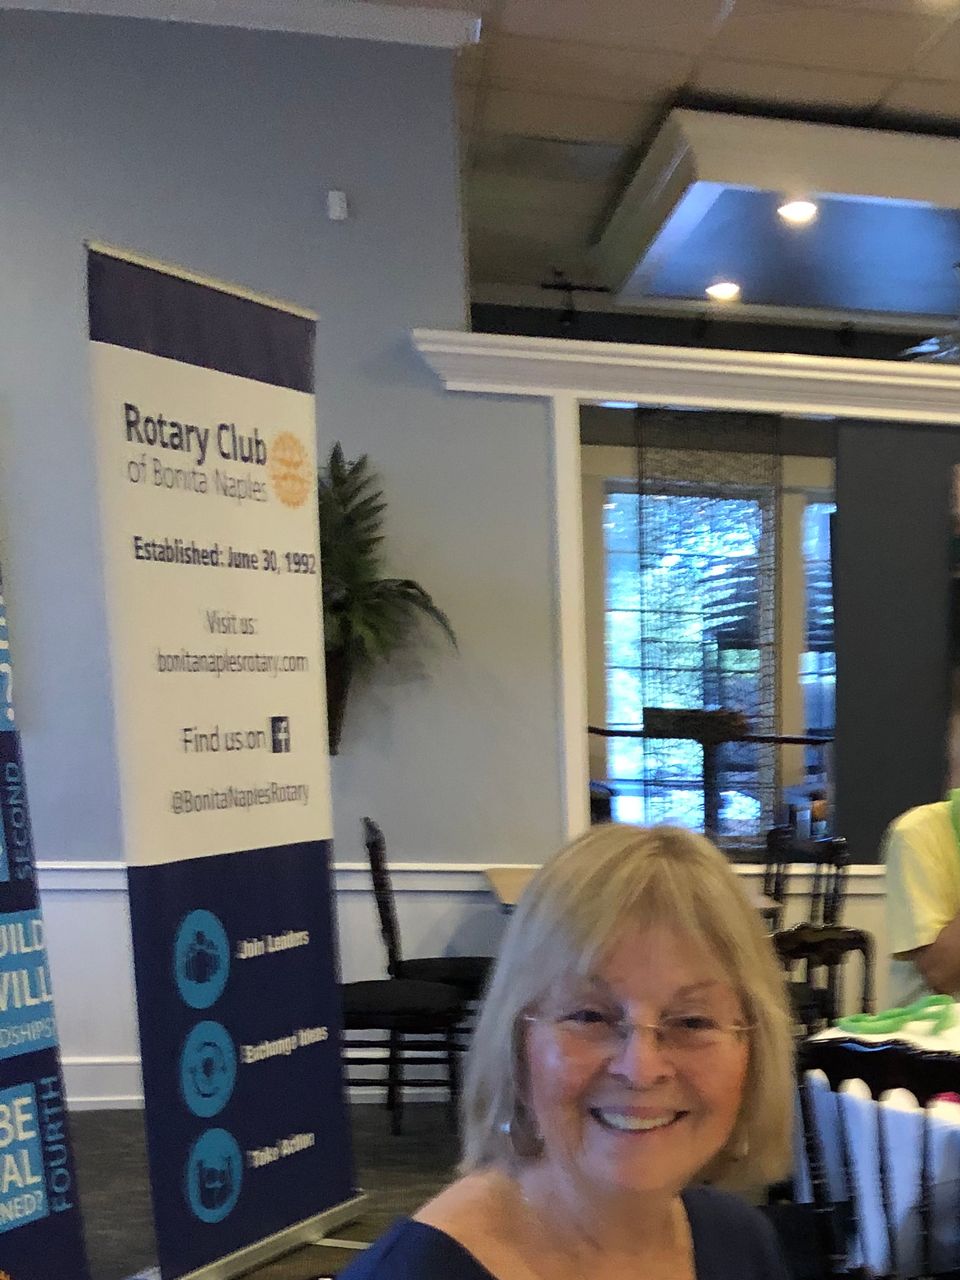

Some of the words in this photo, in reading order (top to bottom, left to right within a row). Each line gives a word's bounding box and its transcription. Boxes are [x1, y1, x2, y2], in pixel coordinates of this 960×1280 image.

[124, 402, 210, 465] Rotary
[216, 422, 268, 465] Club
[126, 453, 147, 483] of
[153, 458, 209, 494] Bonita
[215, 468, 268, 503] Naples
[133, 535, 225, 567] Established:
[228, 547, 259, 570] June
[262, 550, 281, 573] 30,
[285, 551, 316, 575] 1992
[206, 609, 237, 634] Visit
[157, 650, 309, 678] bonitanaplesrotary.com
[182, 725, 221, 753] Find
[225, 730, 244, 751] us
[246, 729, 267, 750] on
[171, 781, 309, 815] @BonitaNaplesRotary
[40, 1075, 74, 1212] FOURTH
